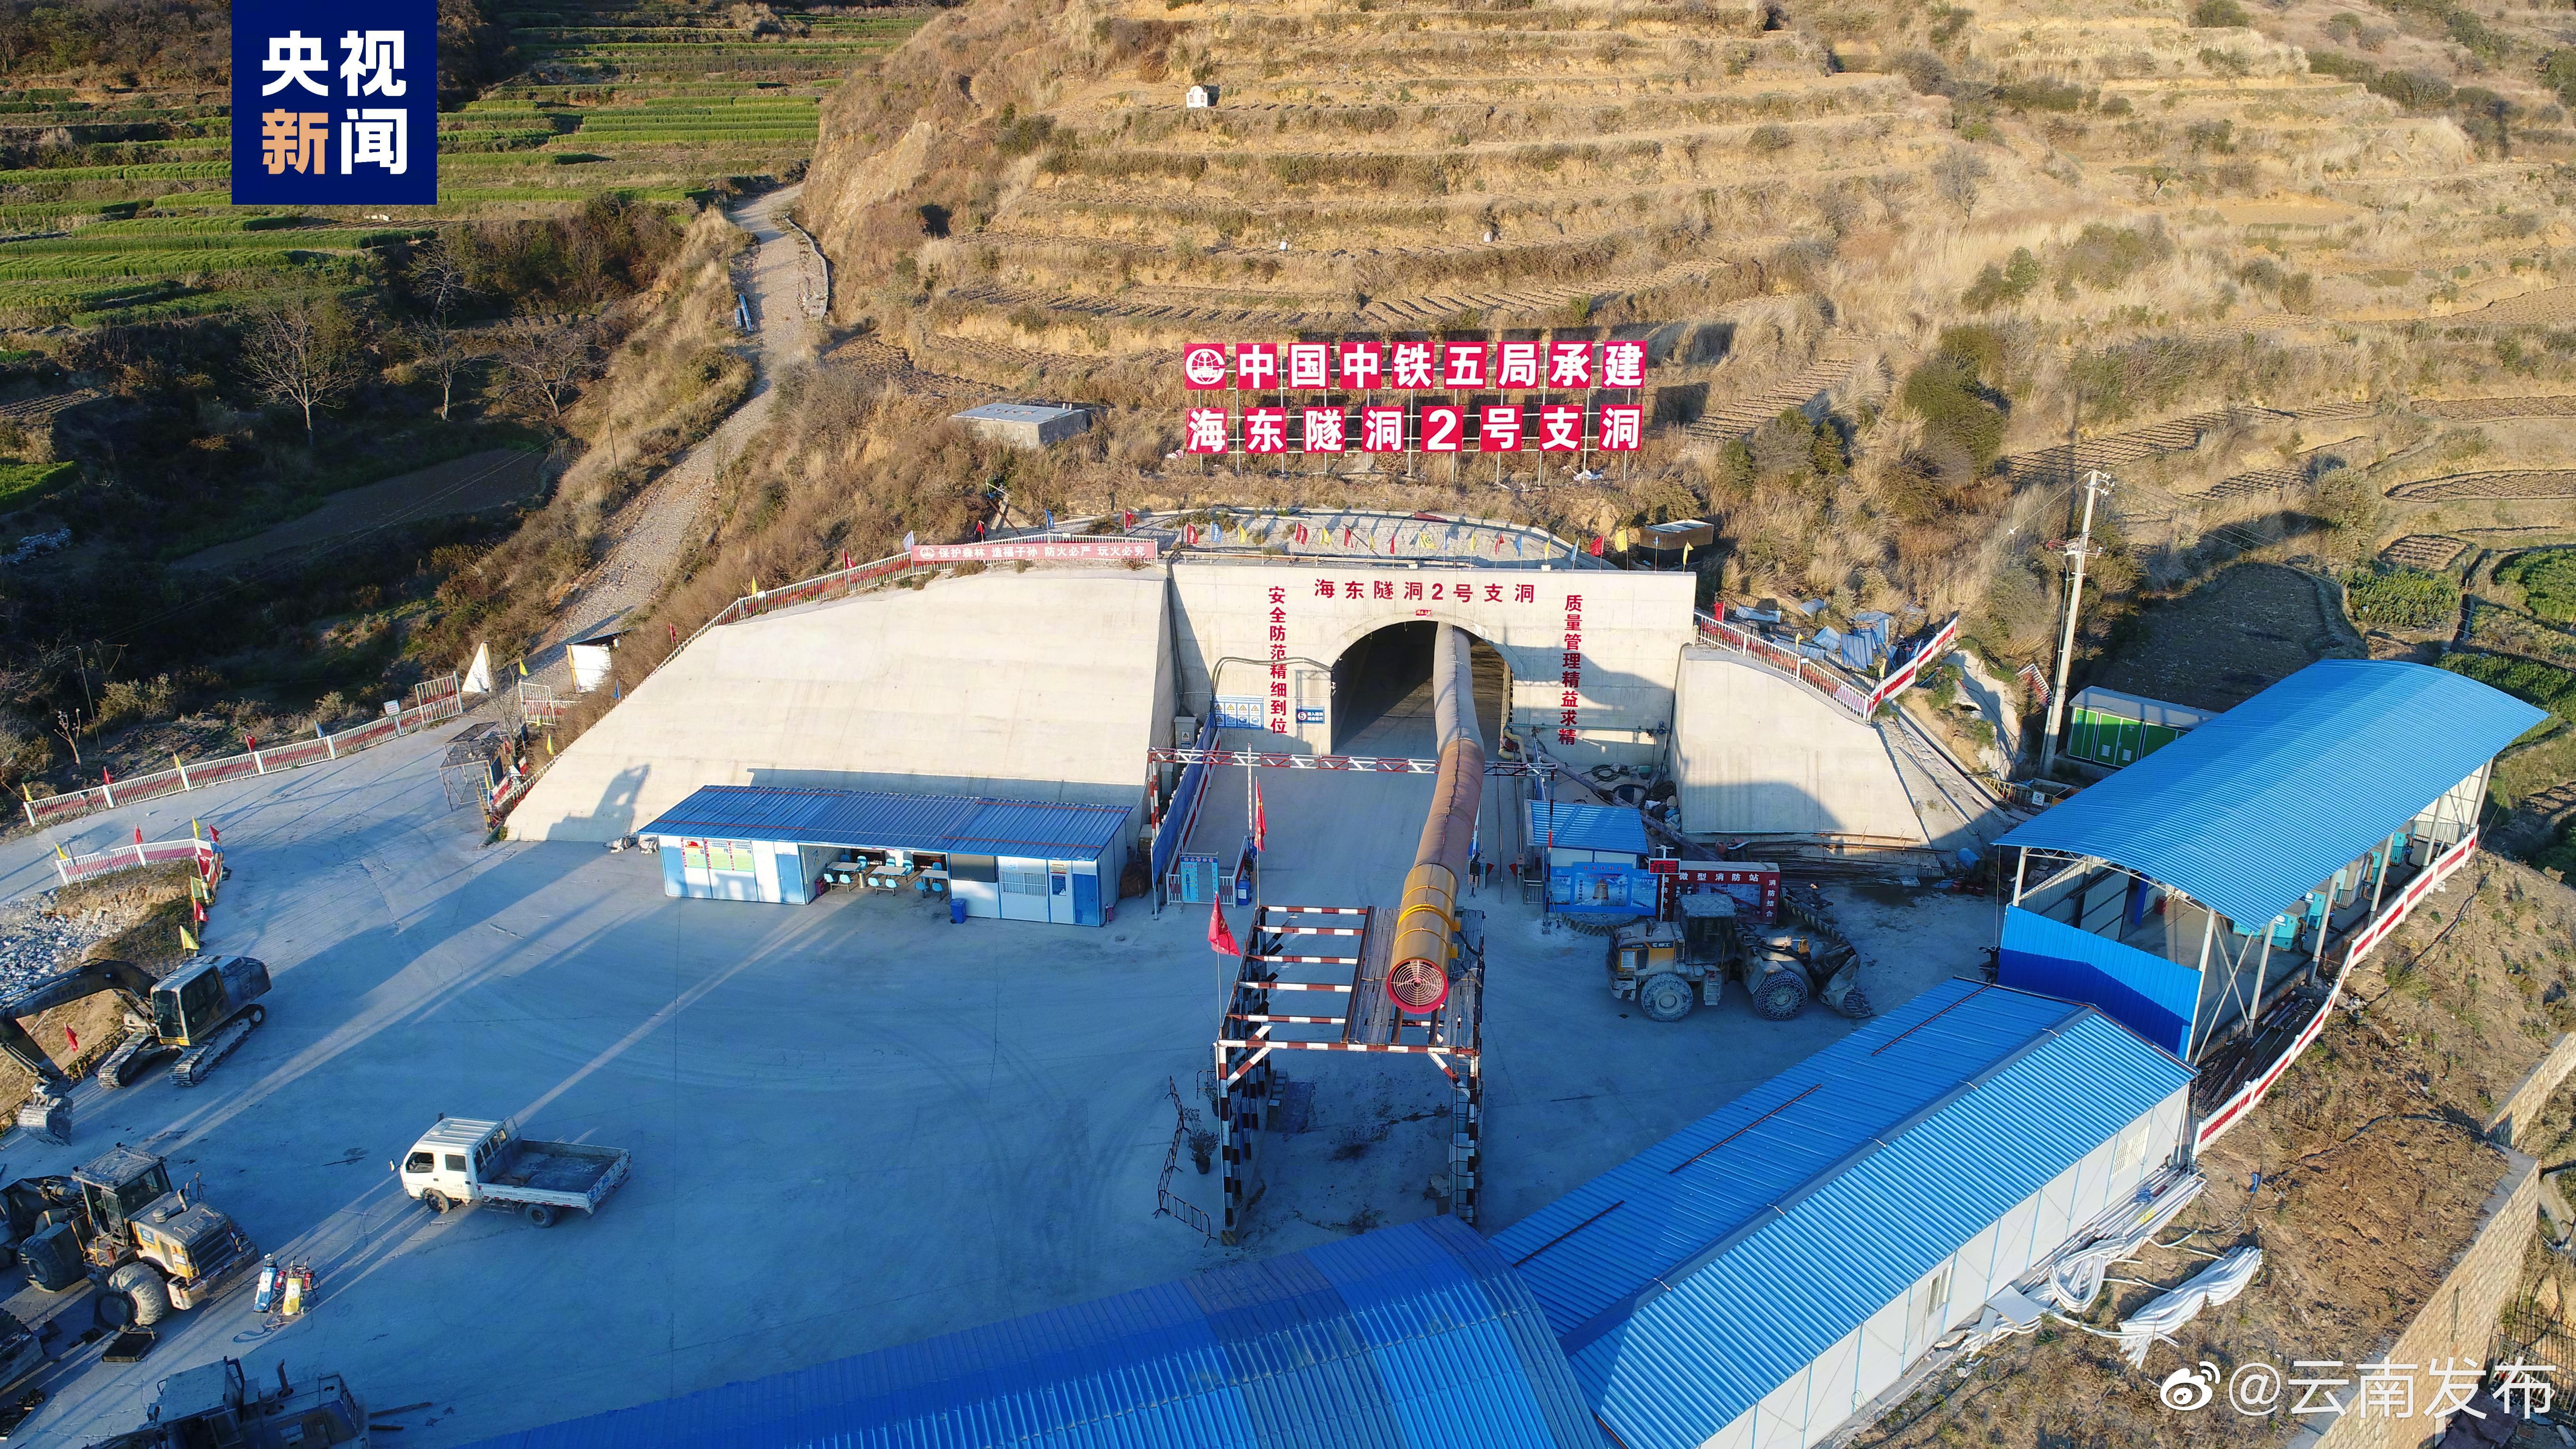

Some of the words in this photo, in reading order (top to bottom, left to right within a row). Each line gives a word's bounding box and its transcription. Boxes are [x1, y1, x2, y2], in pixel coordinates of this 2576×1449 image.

[1239, 342, 1643, 389] 中国中铁五局承建
[1187, 407, 1641, 452] 海东隧洞2号支洞
[939, 547, 985, 558] 保护森林
[991, 547, 1038, 558] 造福子孙
[1045, 546, 1091, 557] 防火必严
[1097, 545, 1146, 556] 玩火必究
[1314, 579, 1535, 603] 海东隧洞2号支洞
[1269, 586, 1287, 733] 安全防范精细到位
[1558, 594, 1582, 745] 质量管理精益求精
[1679, 872, 1759, 882] 微型消防站
[1765, 879, 1777, 918] 消防结合
